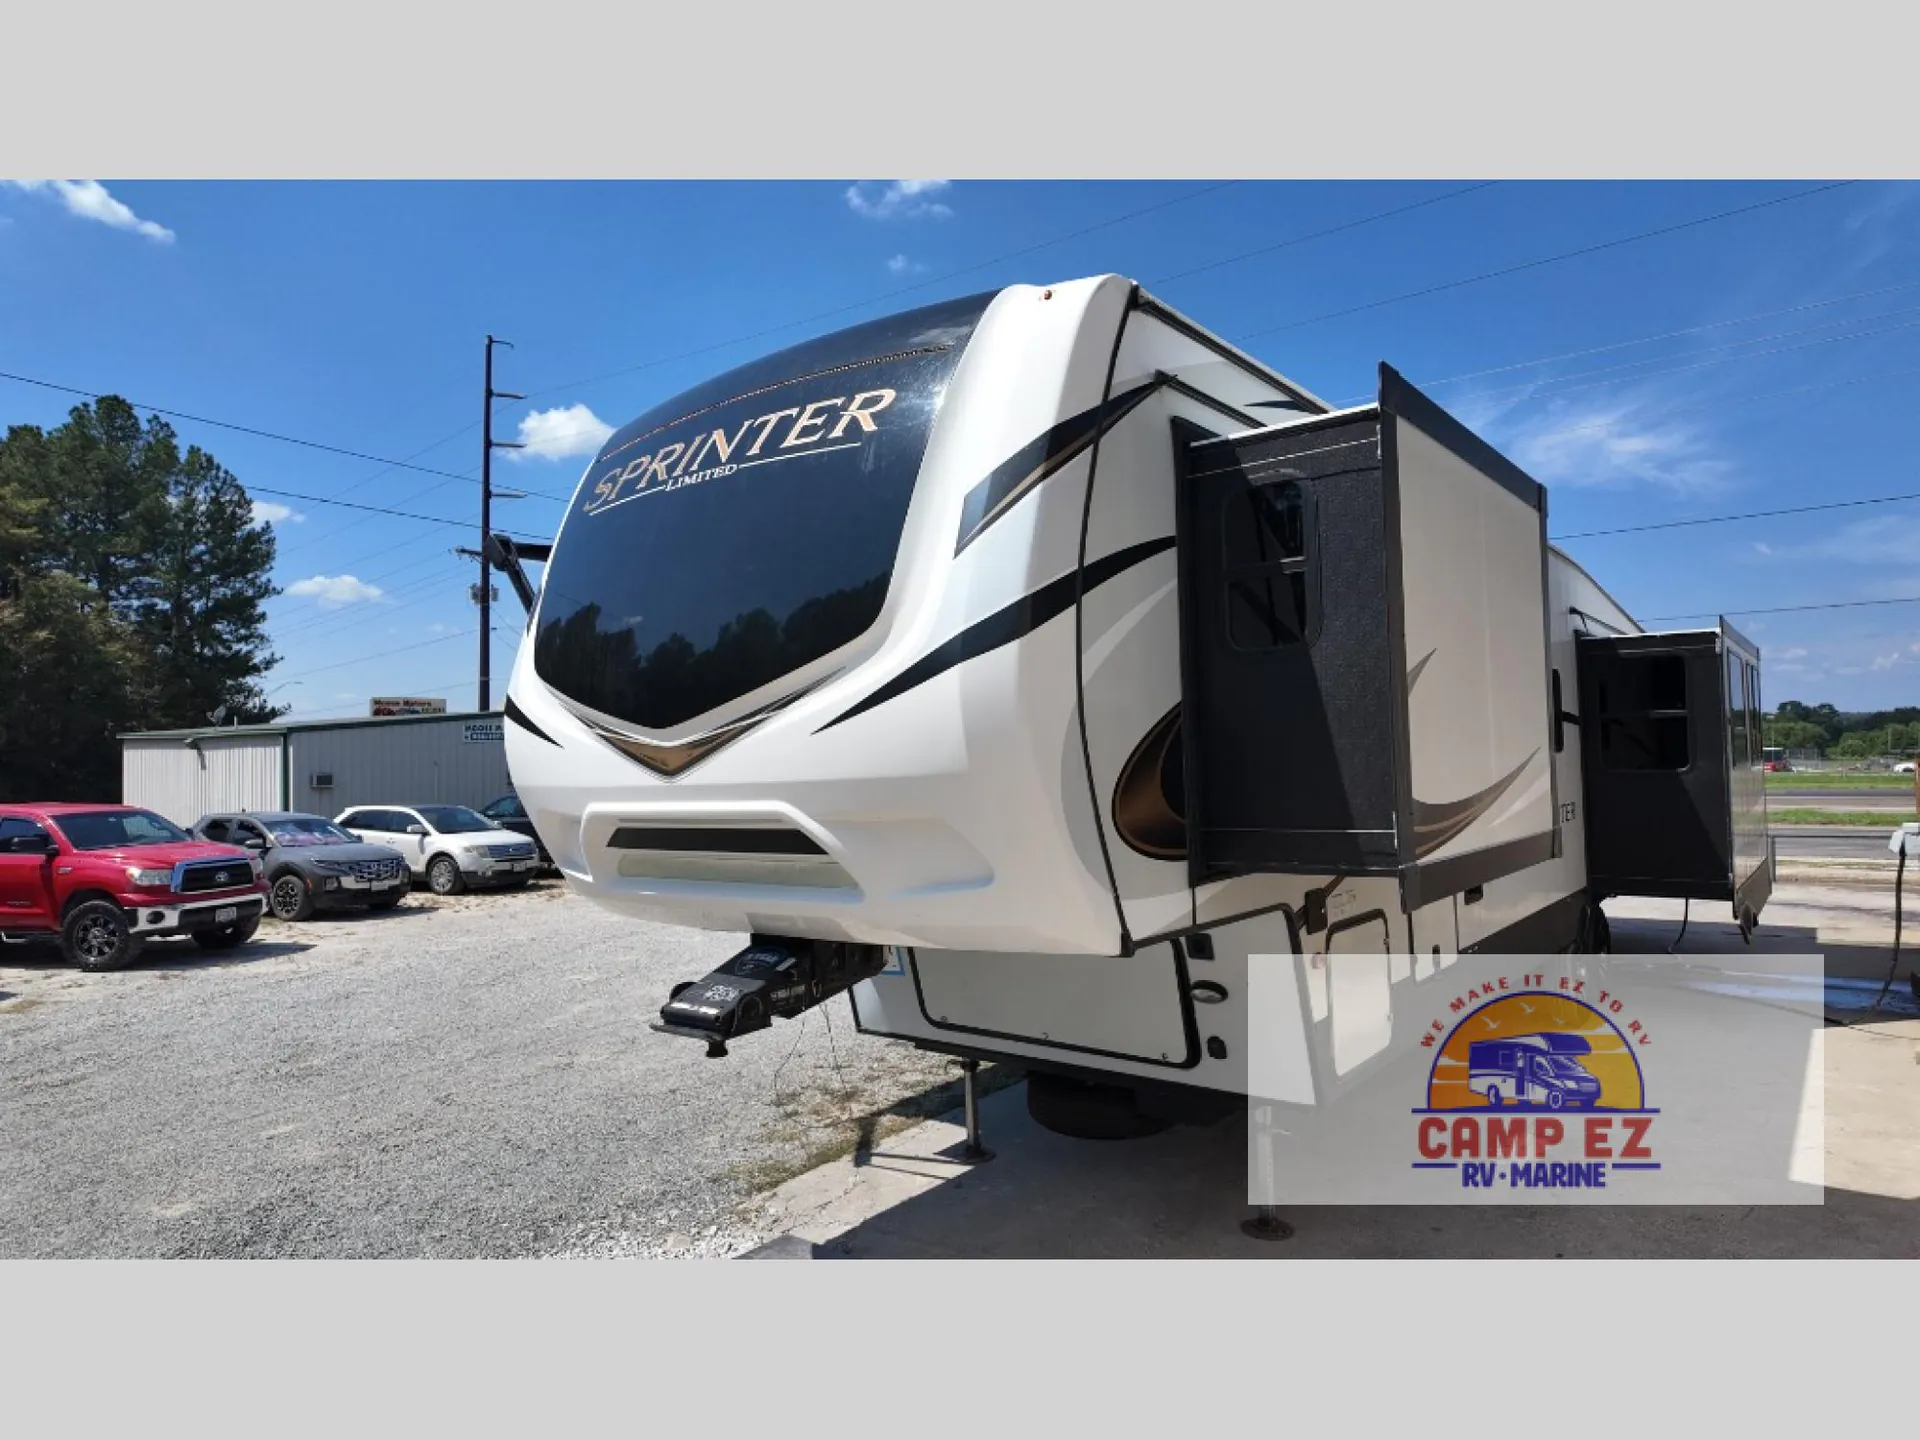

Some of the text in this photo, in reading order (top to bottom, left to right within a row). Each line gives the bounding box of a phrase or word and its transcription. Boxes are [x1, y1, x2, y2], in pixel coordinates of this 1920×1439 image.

[583, 388, 897, 512] SPRINTER
[665, 464, 738, 491] LIMITED
[1560, 801, 1576, 823] TER
